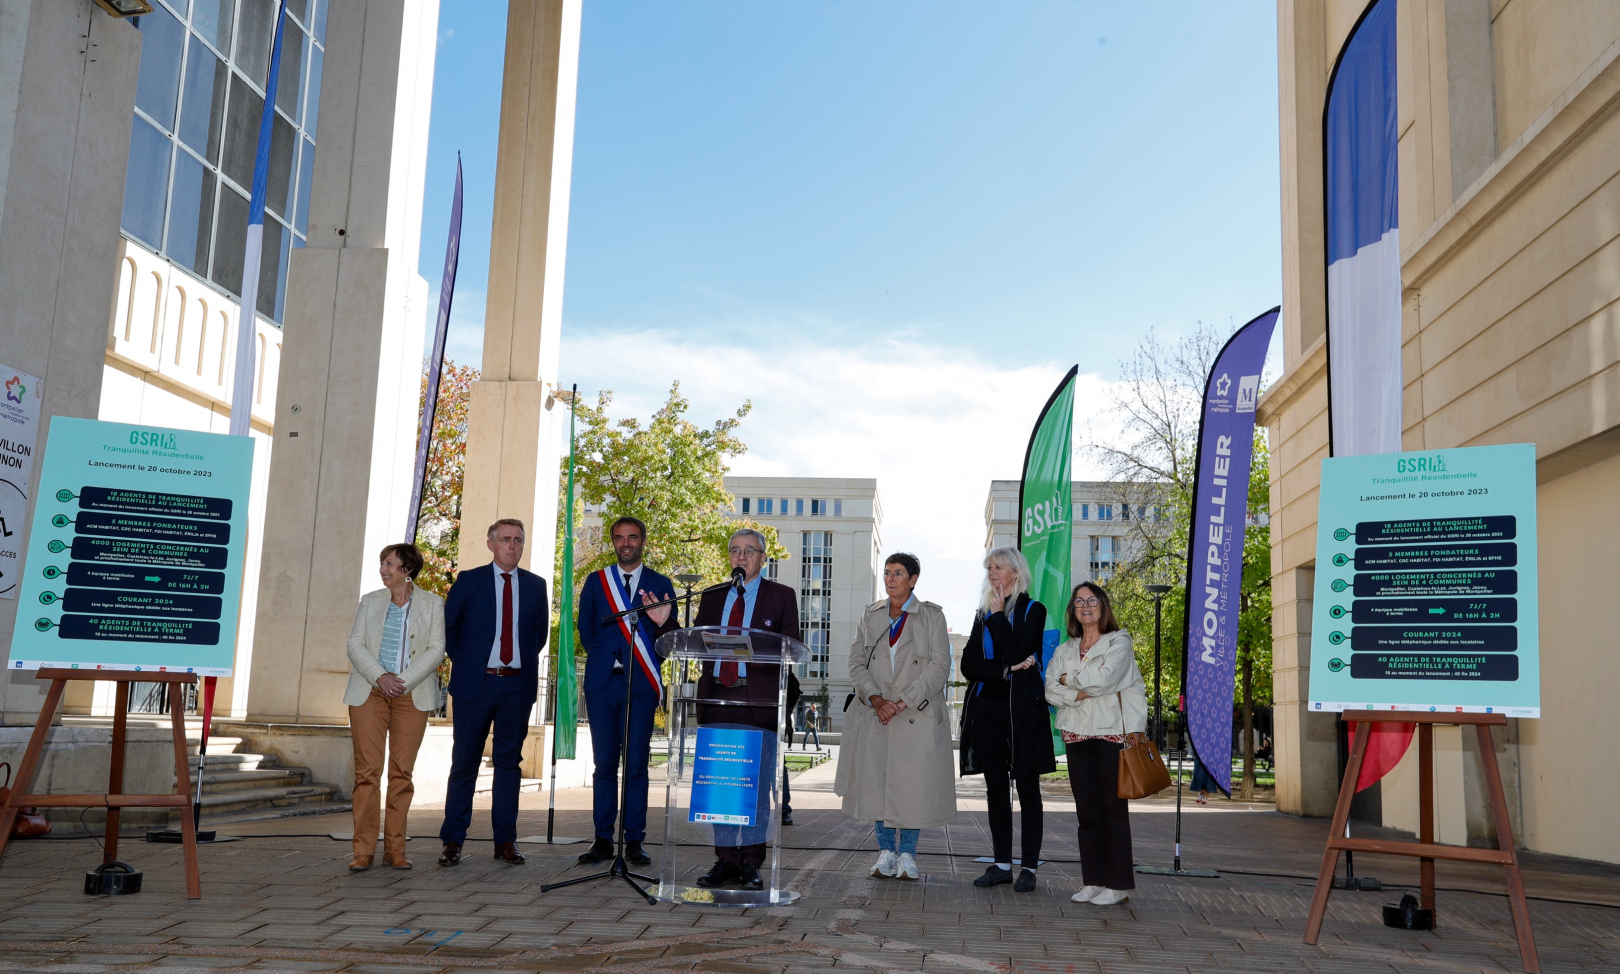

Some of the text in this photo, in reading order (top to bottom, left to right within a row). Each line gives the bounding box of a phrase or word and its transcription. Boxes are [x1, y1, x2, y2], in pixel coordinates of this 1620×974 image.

[1240, 388, 1253, 402] M
[0, 402, 24, 414] ontpellier
[129, 430, 164, 447] GSRI
[101, 444, 204, 460] Tranquillité Résidentielle
[0, 453, 22, 469] NON
[88, 459, 135, 470] Lancement
[159, 466, 191, 475] octobre
[1397, 456, 1432, 473] GSRI
[1371, 471, 1477, 485] Tranquillité Résidentielle
[107, 495, 155, 504] RÉSIDENTIELLE
[158, 494, 203, 504] TRANQUILLITÉ
[1360, 493, 1405, 501] Lancement
[153, 522, 197, 530] FONDATEURS
[1433, 518, 1482, 526] TRANQUILLITÉ
[156, 543, 197, 552] CONCERNÉS
[1201, 434, 1232, 665] MONTPELLIER
[0, 550, 16, 558] CCÈS
[1220, 524, 1232, 611] MÉTROPOLE
[99, 624, 152, 632] RÉSIDENTIELLE
[142, 620, 192, 629] TRANQUILLITÉ
[1216, 629, 1225, 666] VILLE
[1432, 656, 1485, 664] TRANQUILLITÉ
